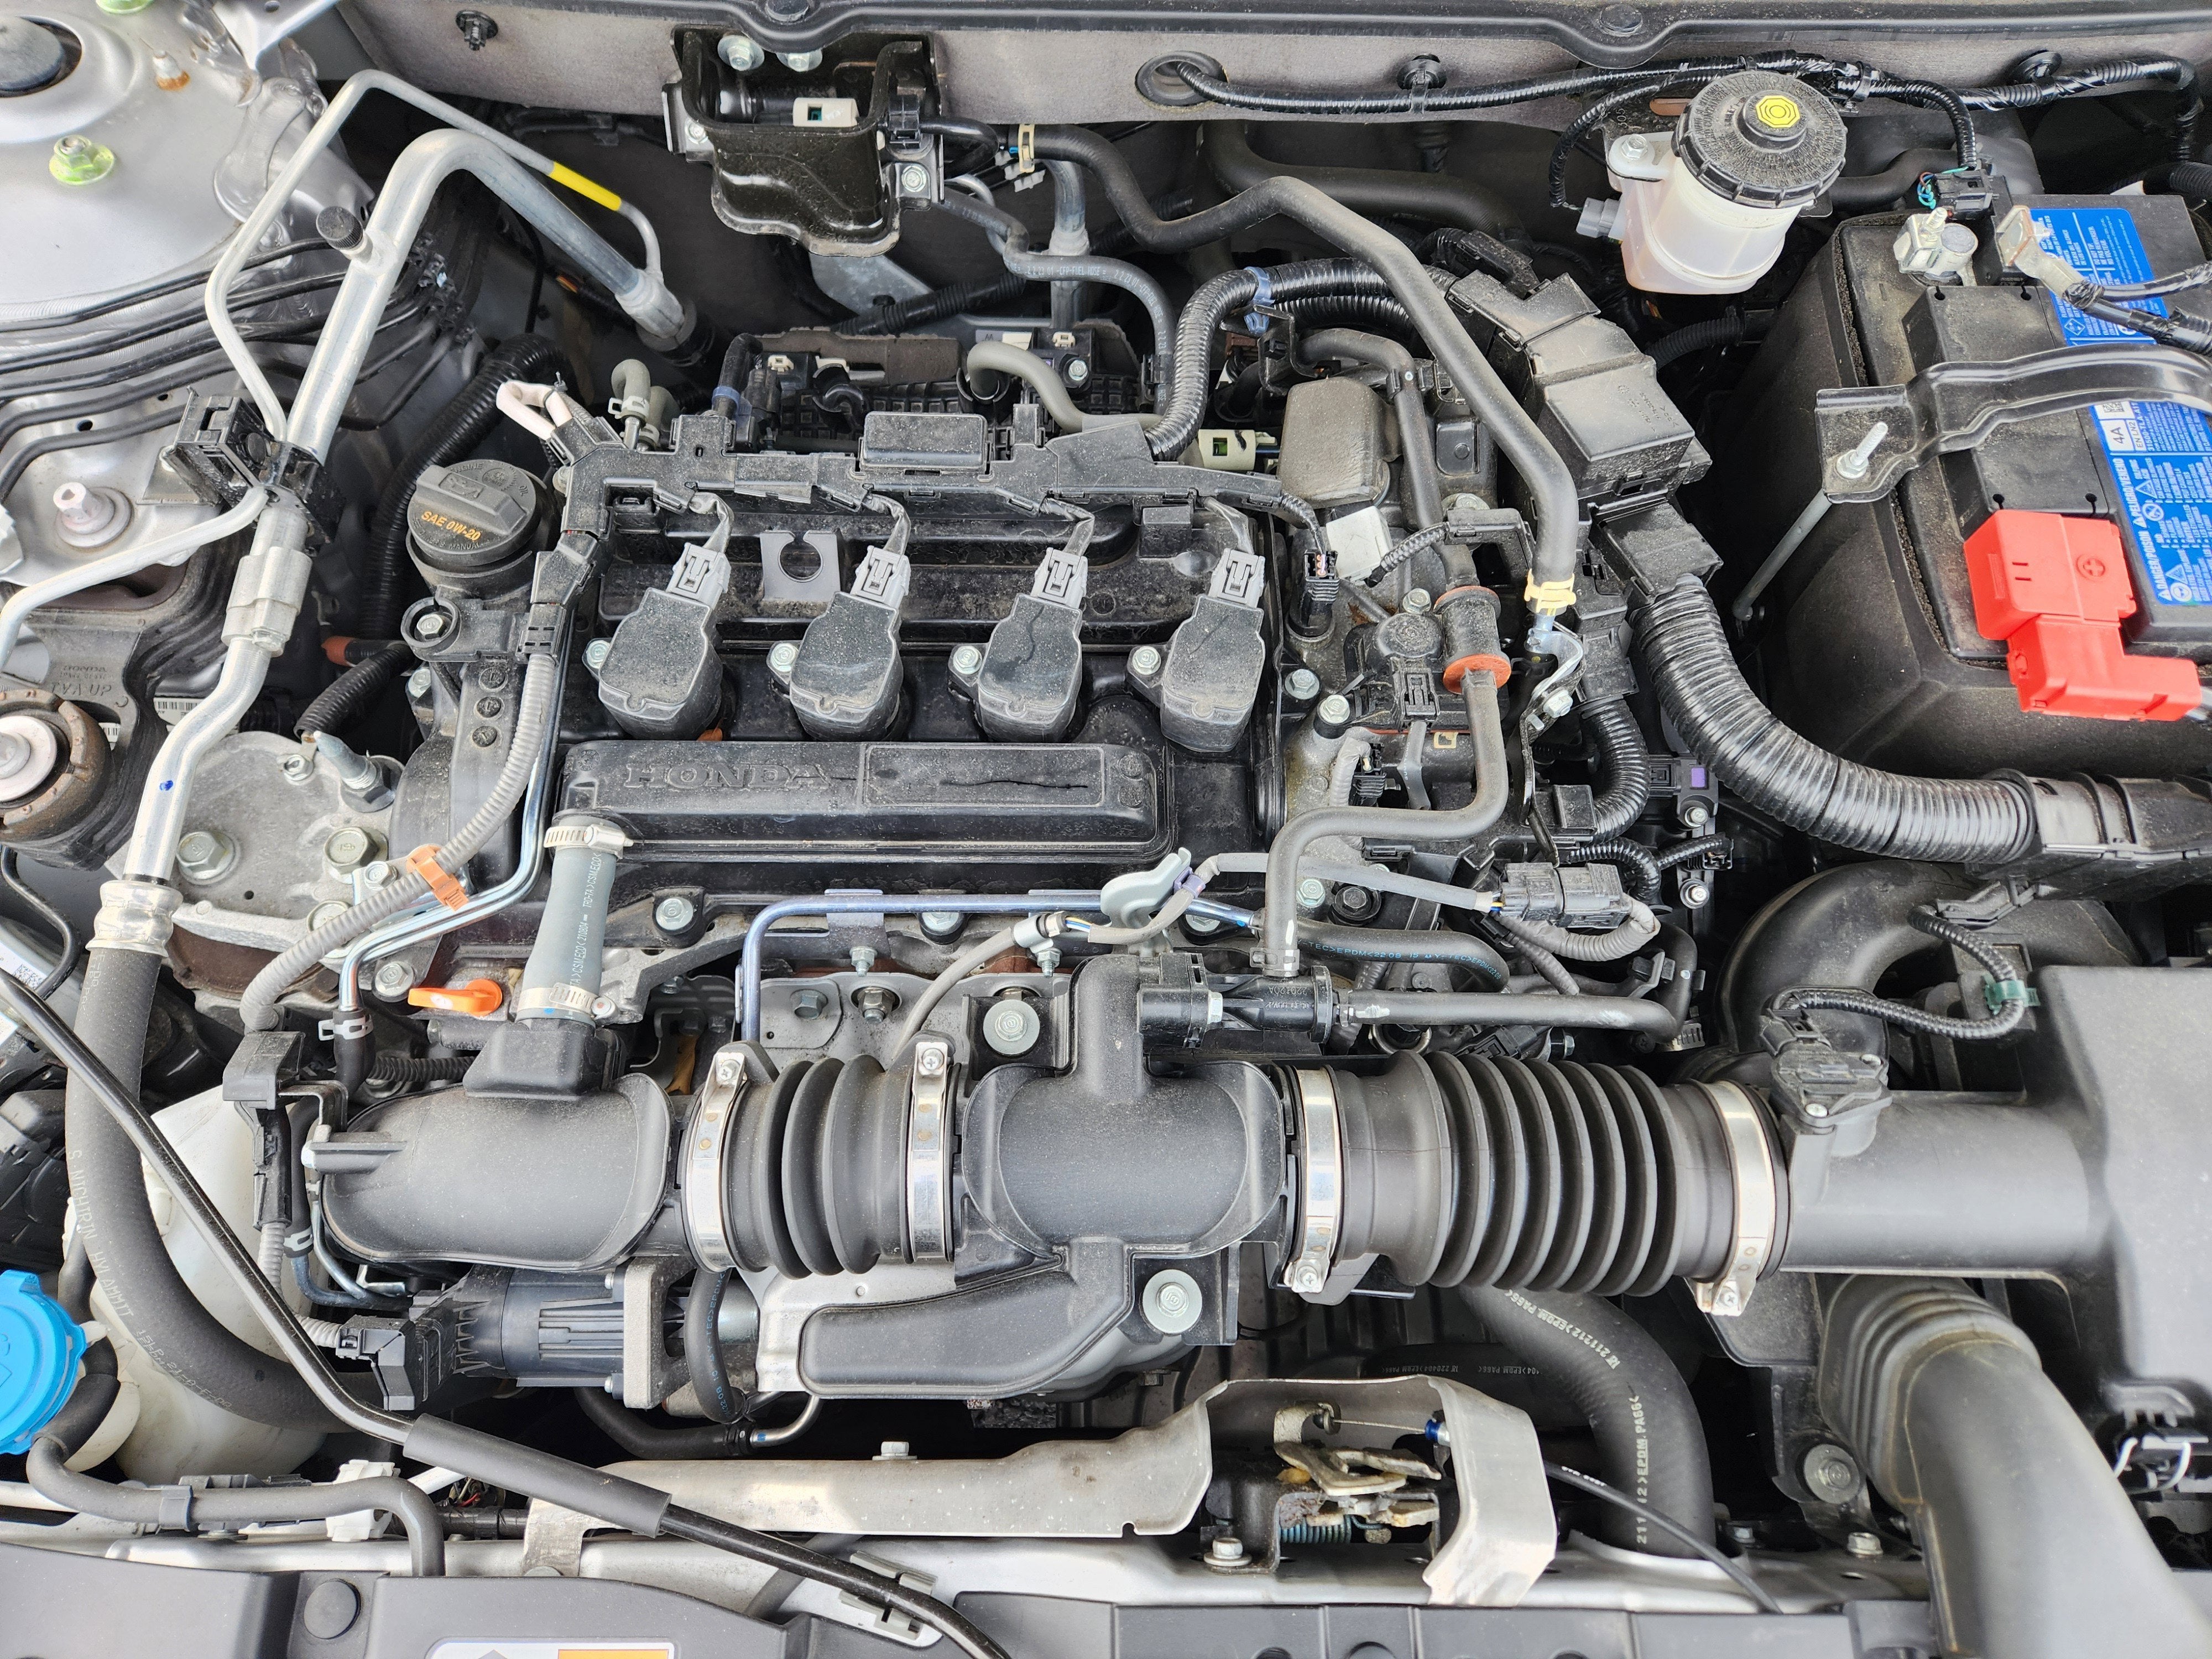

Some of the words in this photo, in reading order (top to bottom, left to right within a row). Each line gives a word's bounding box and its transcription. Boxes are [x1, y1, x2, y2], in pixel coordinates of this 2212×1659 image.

[2109, 427, 2126, 444] 4A
[2128, 422, 2138, 435] LN2
[2134, 438, 2143, 447] EN
[2111, 458, 2143, 517] PELIGRO/VENENO
[421, 511, 447, 526] SAE
[446, 521, 482, 542] 0W-20
[2137, 531, 2168, 589] DANGER/POISON
[624, 763, 830, 789] HONDA
